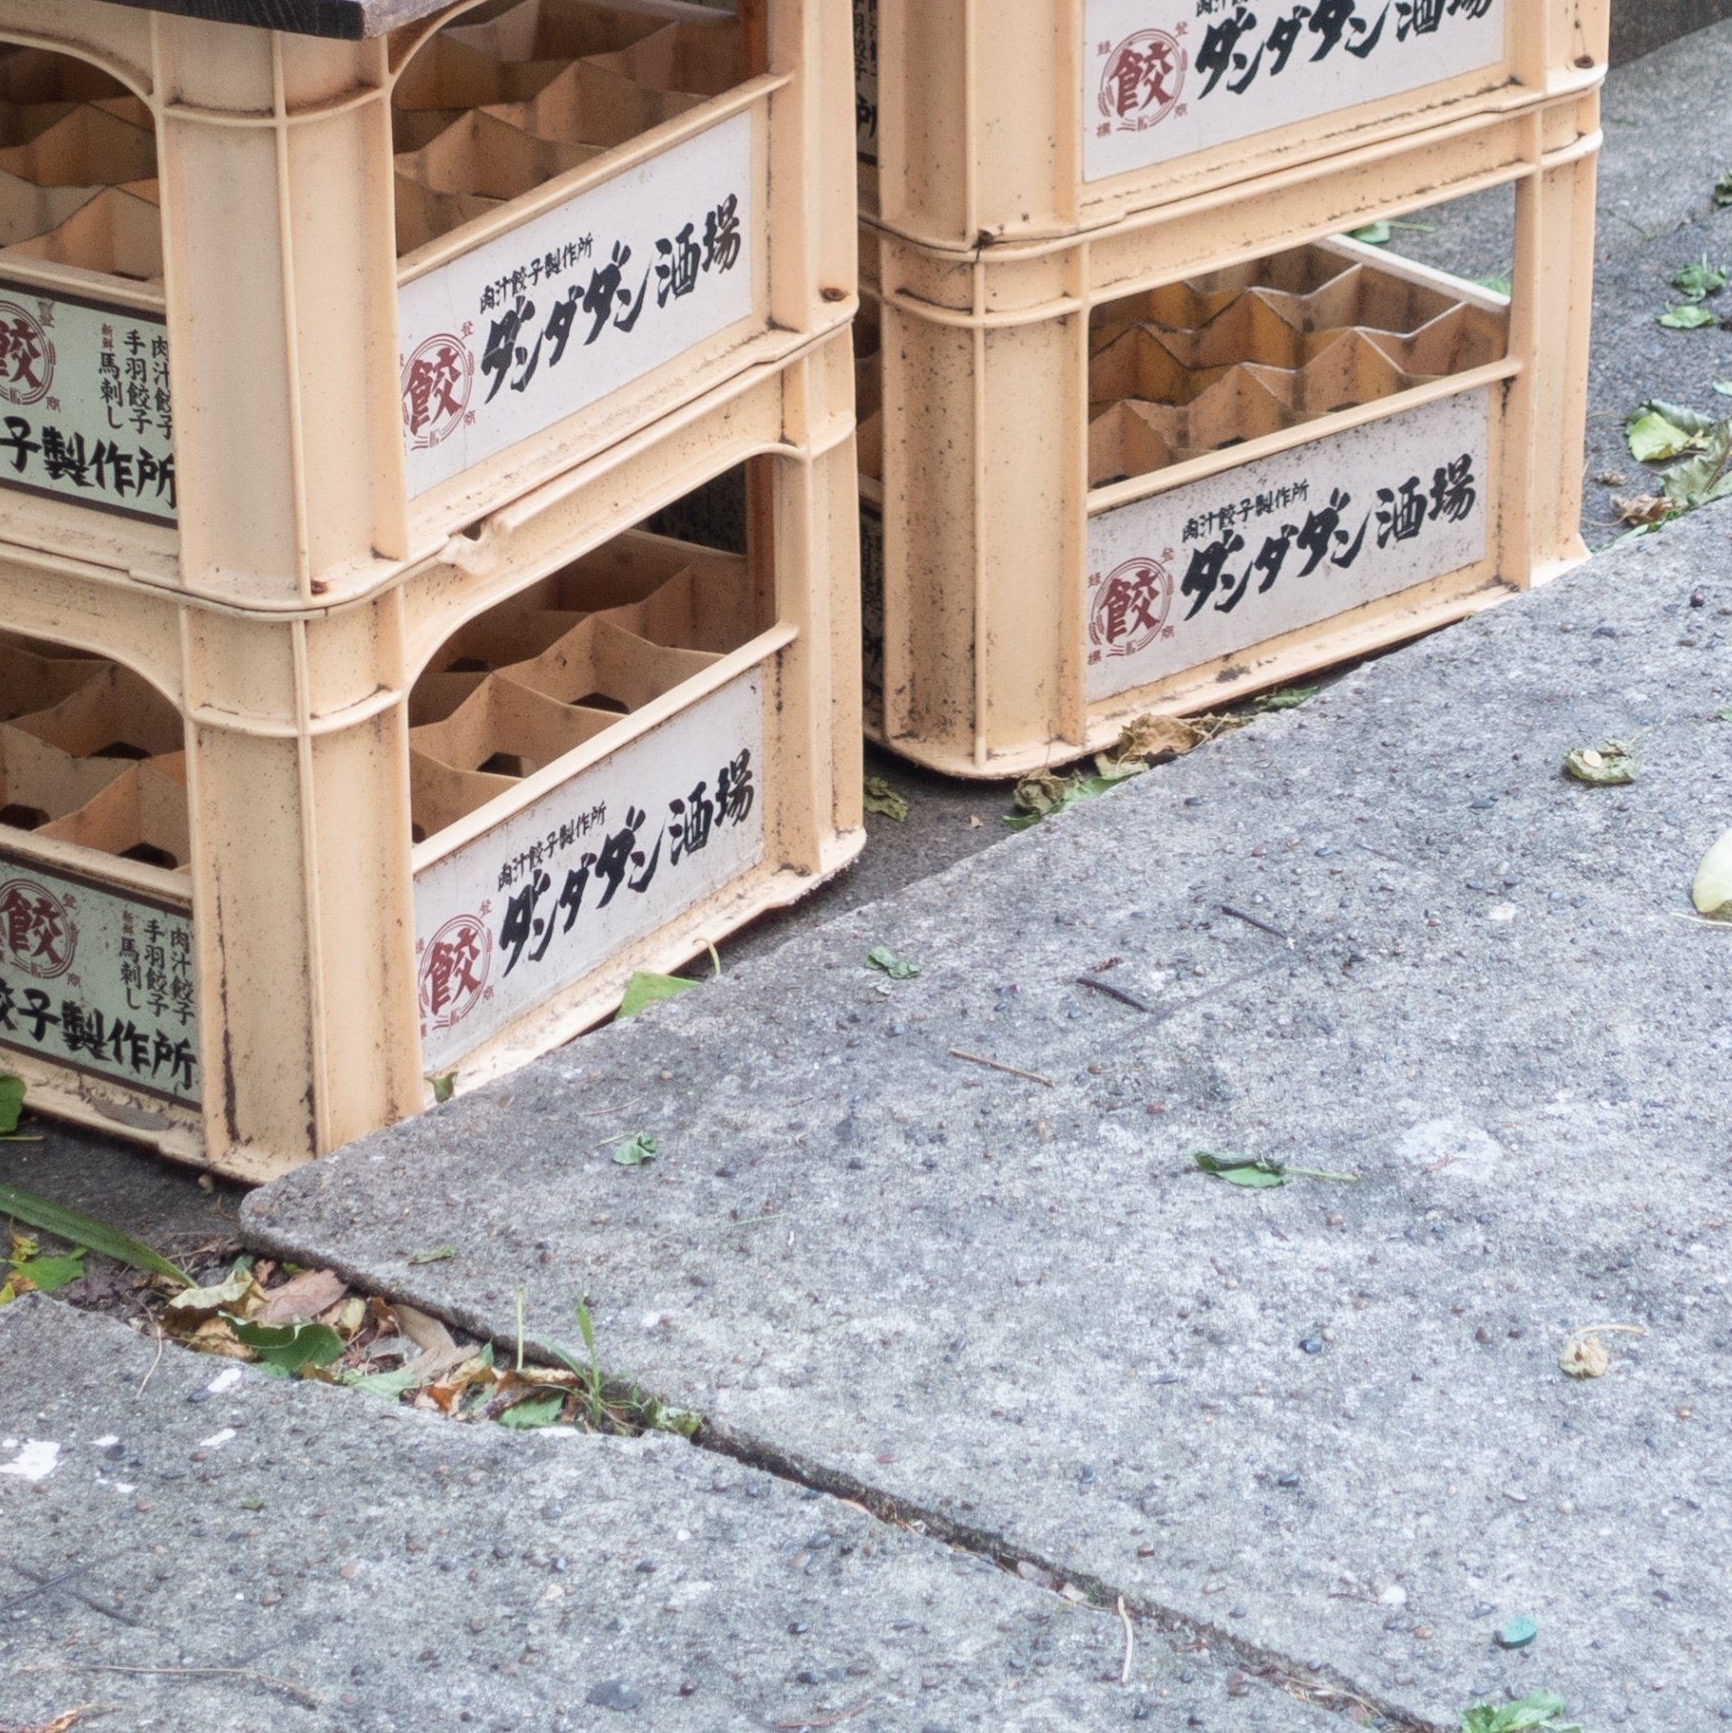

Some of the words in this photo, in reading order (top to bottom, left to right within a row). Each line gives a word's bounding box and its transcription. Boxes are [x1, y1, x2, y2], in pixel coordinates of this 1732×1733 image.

[1107, 41, 1174, 118] 餃
[479, 232, 593, 314] 肉汁餃子製作所
[481, 193, 742, 404] ダンダダン酒場
[123, 329, 153, 435] 手羽餃子
[401, 347, 463, 437] 餃
[1180, 453, 1478, 622] ダンダダン酒場
[1182, 479, 1309, 543] 肉汁餃子製作所
[1097, 569, 1161, 644] 餃
[498, 801, 607, 892] 肉汁餃子製作所
[498, 748, 755, 978] ダンダダン酒場
[144, 919, 170, 1018] 手羽餃子
[171, 927, 195, 1026] 肉汁餃子
[423, 927, 482, 1016] 餃
